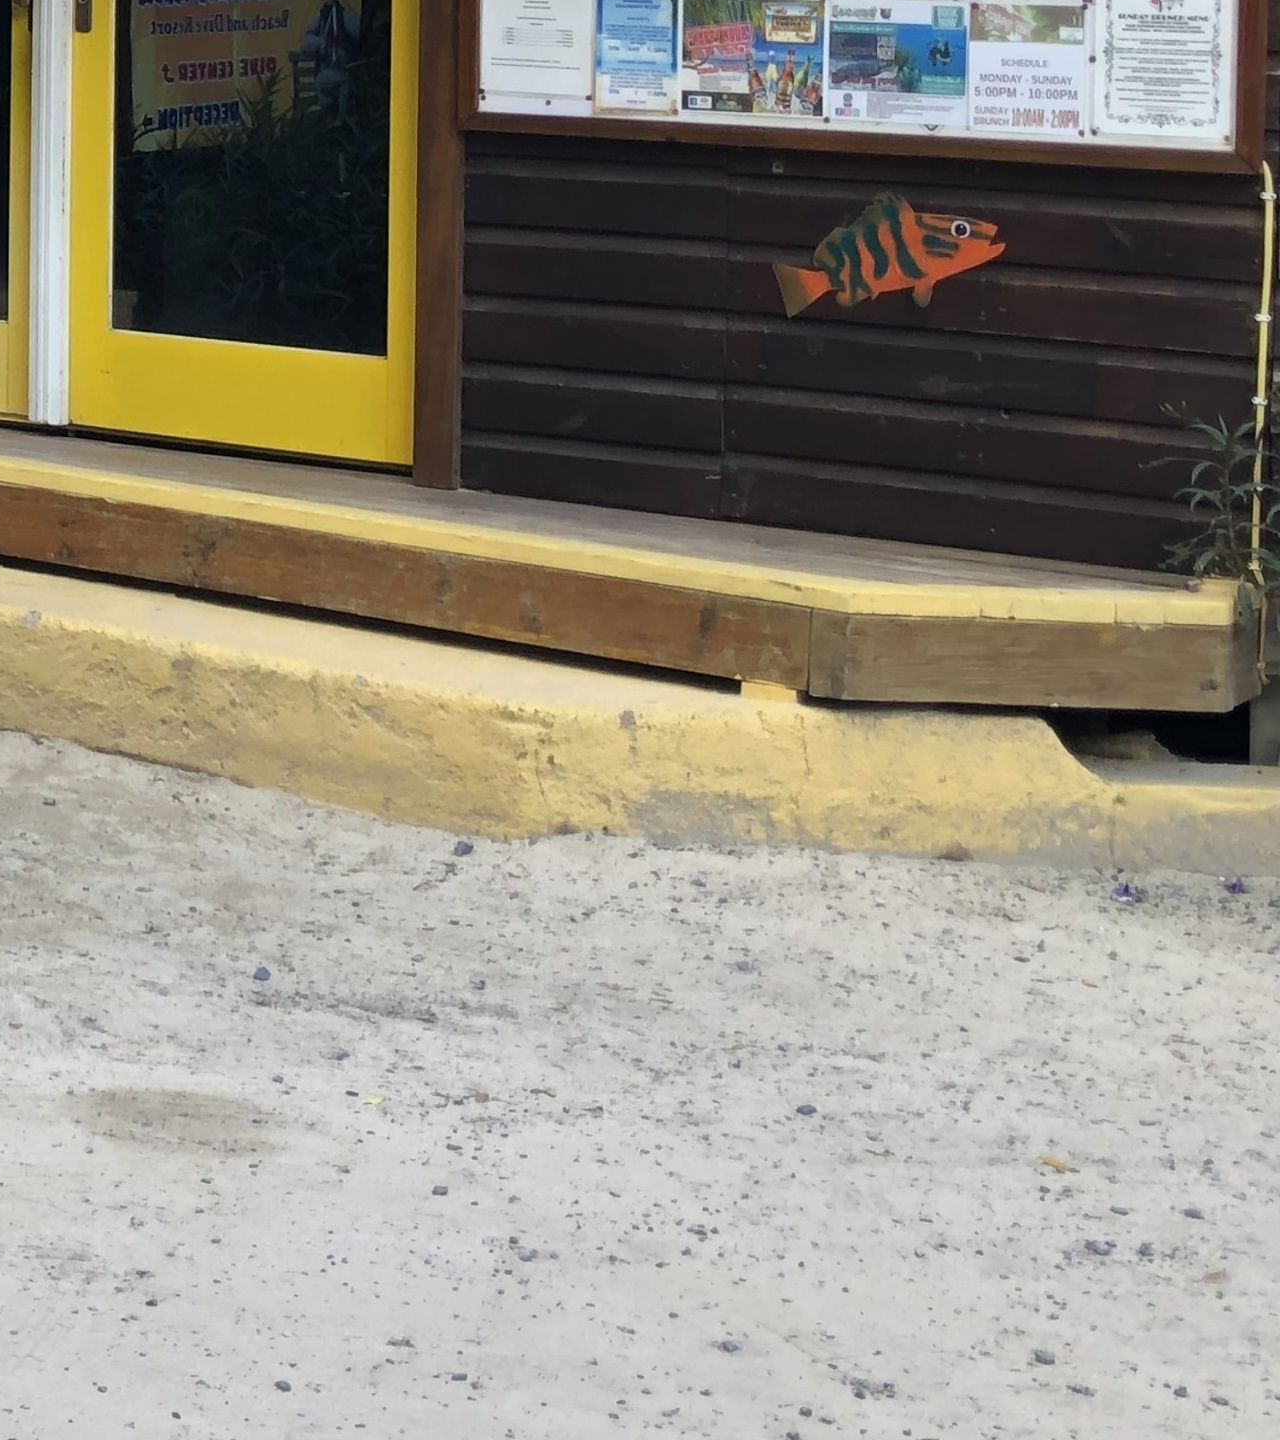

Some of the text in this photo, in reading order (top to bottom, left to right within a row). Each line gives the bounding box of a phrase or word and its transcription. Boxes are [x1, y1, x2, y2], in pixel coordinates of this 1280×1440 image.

[1001, 59, 1048, 68] SCHEDULE
[980, 74, 1022, 83] MONDAY
[1031, 75, 1072, 85] SUNDAY
[974, 86, 1017, 98] 5:00PM
[1028, 88, 1078, 100] 10:00PM
[974, 106, 1008, 115] SUNDAY
